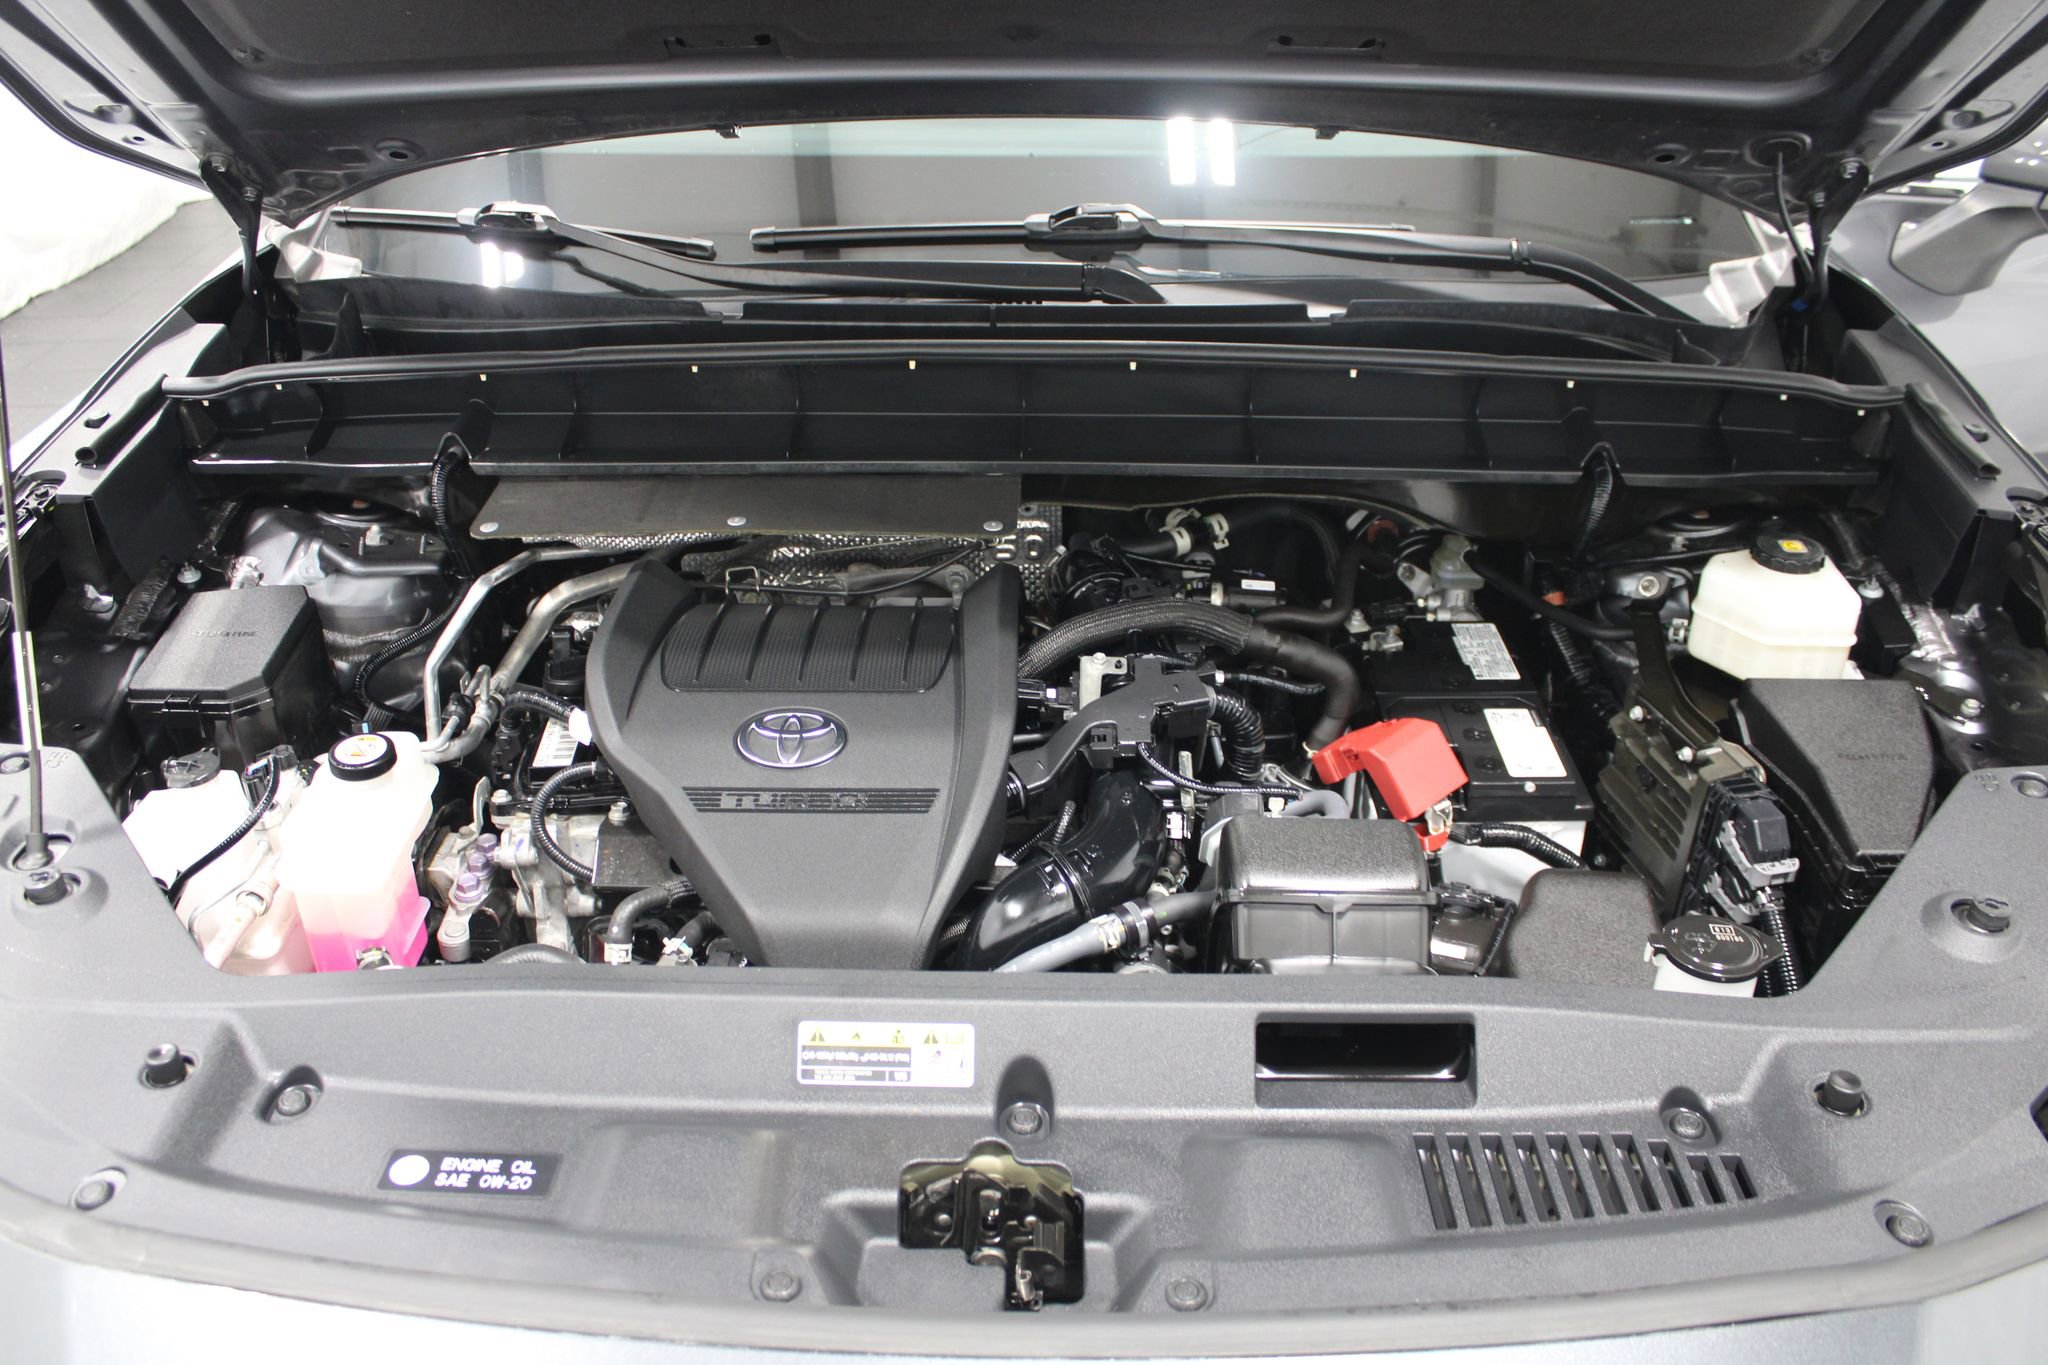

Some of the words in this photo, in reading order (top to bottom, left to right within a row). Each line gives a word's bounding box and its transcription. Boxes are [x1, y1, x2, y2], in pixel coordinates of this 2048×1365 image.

[440, 1157, 503, 1173] ENGINE
[511, 1160, 536, 1175] OIL
[434, 1173, 471, 1187] SAE
[479, 1175, 532, 1190] 0W-20
